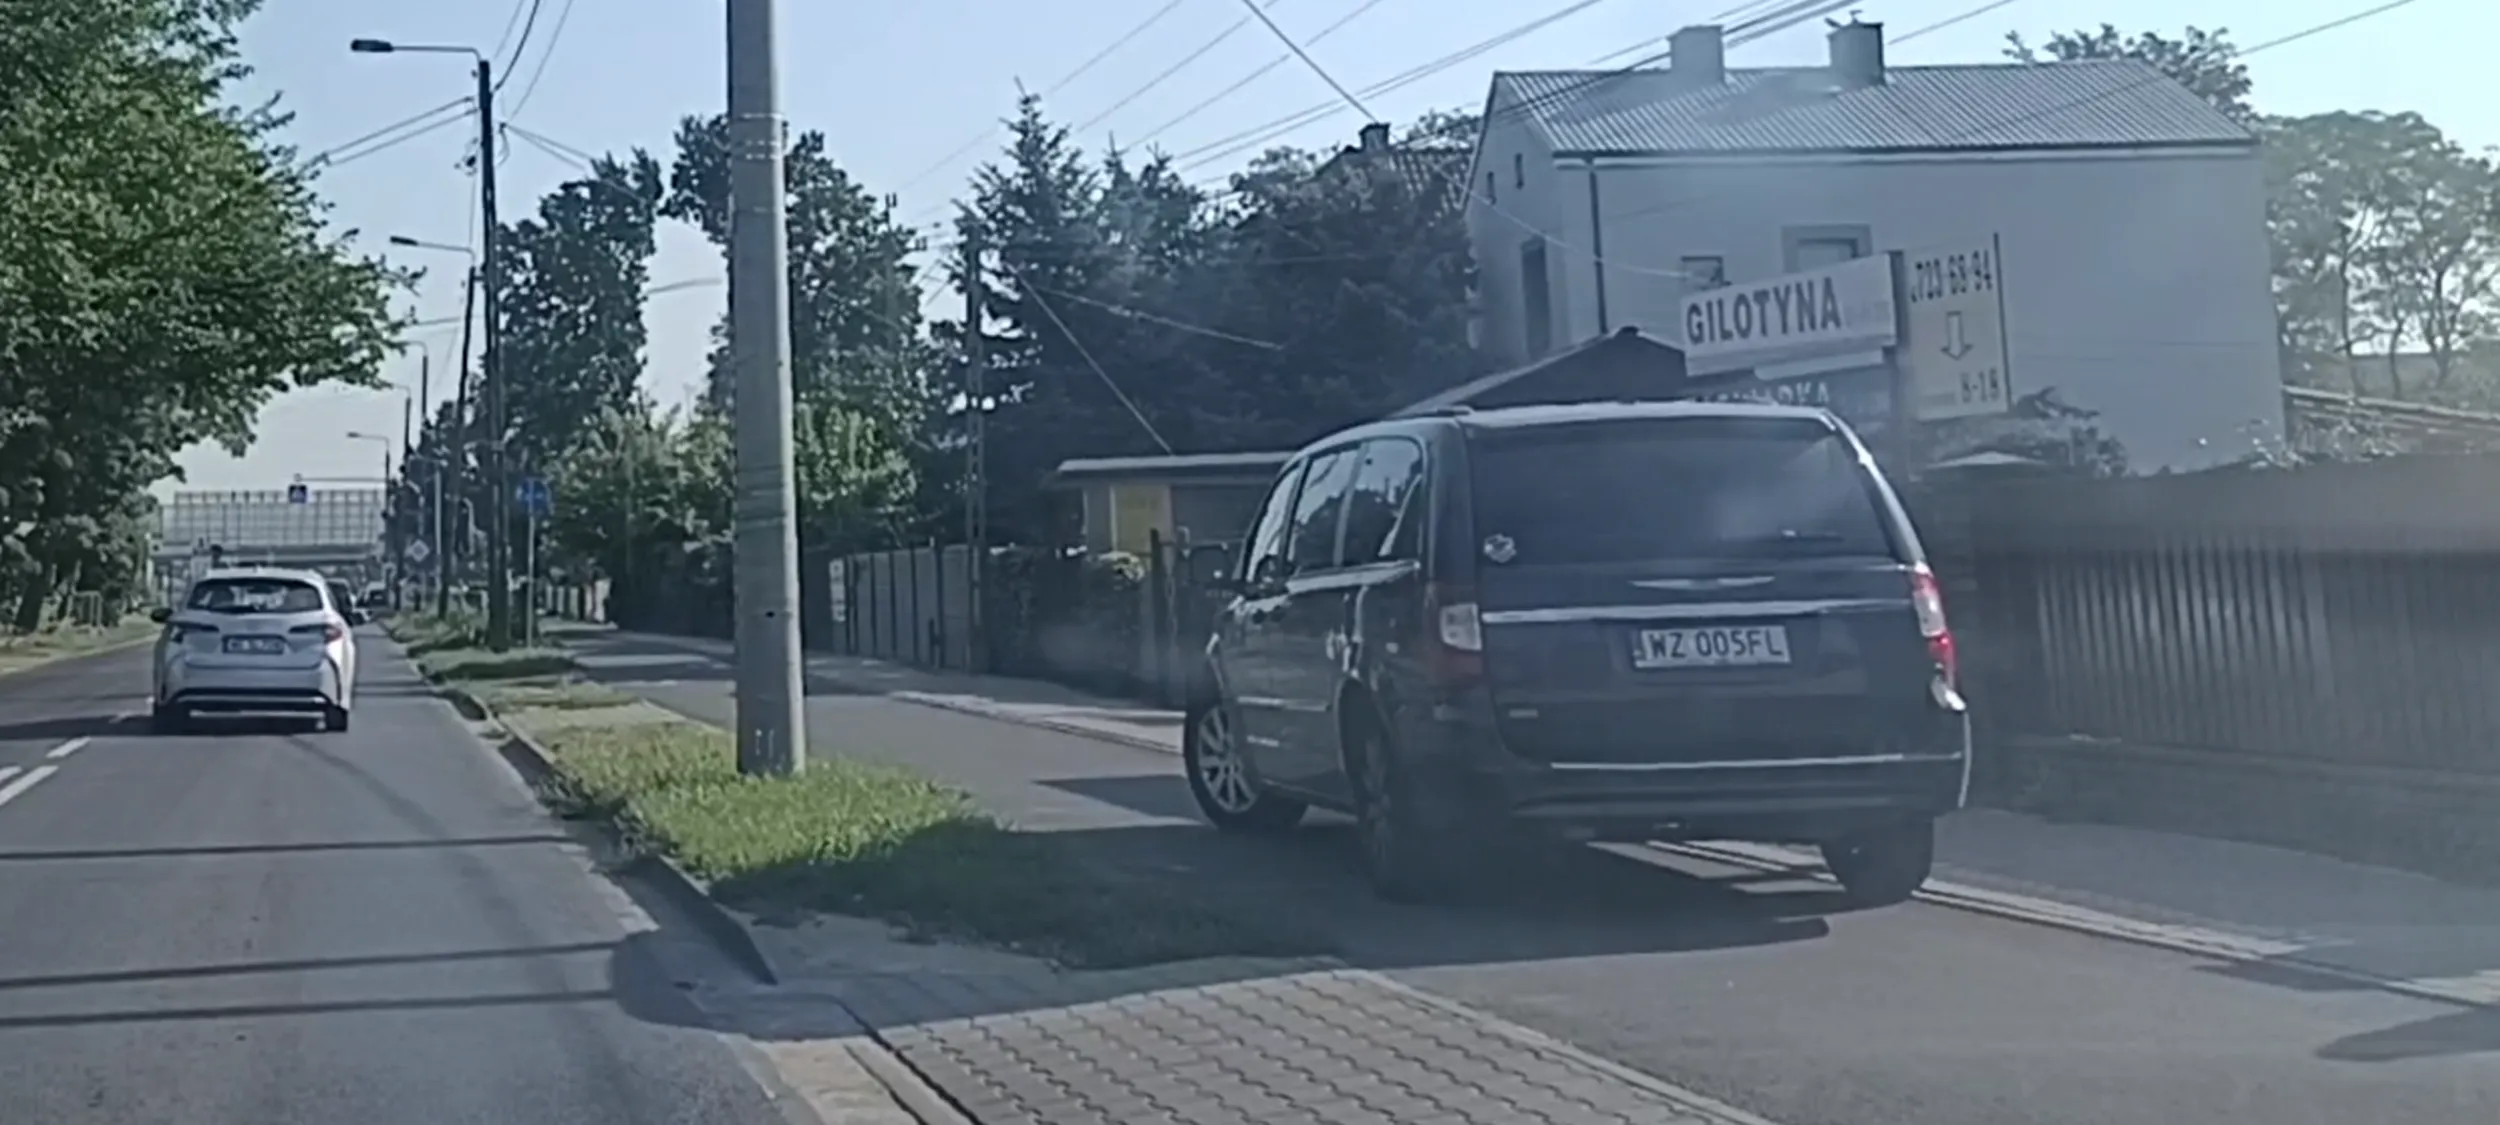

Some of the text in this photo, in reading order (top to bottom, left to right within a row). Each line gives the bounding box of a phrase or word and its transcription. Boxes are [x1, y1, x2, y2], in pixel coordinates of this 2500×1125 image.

[1686, 276, 1842, 345] GILOTYNA
[1648, 631, 1687, 659] WZ
[1695, 628, 1784, 657] 005FL
